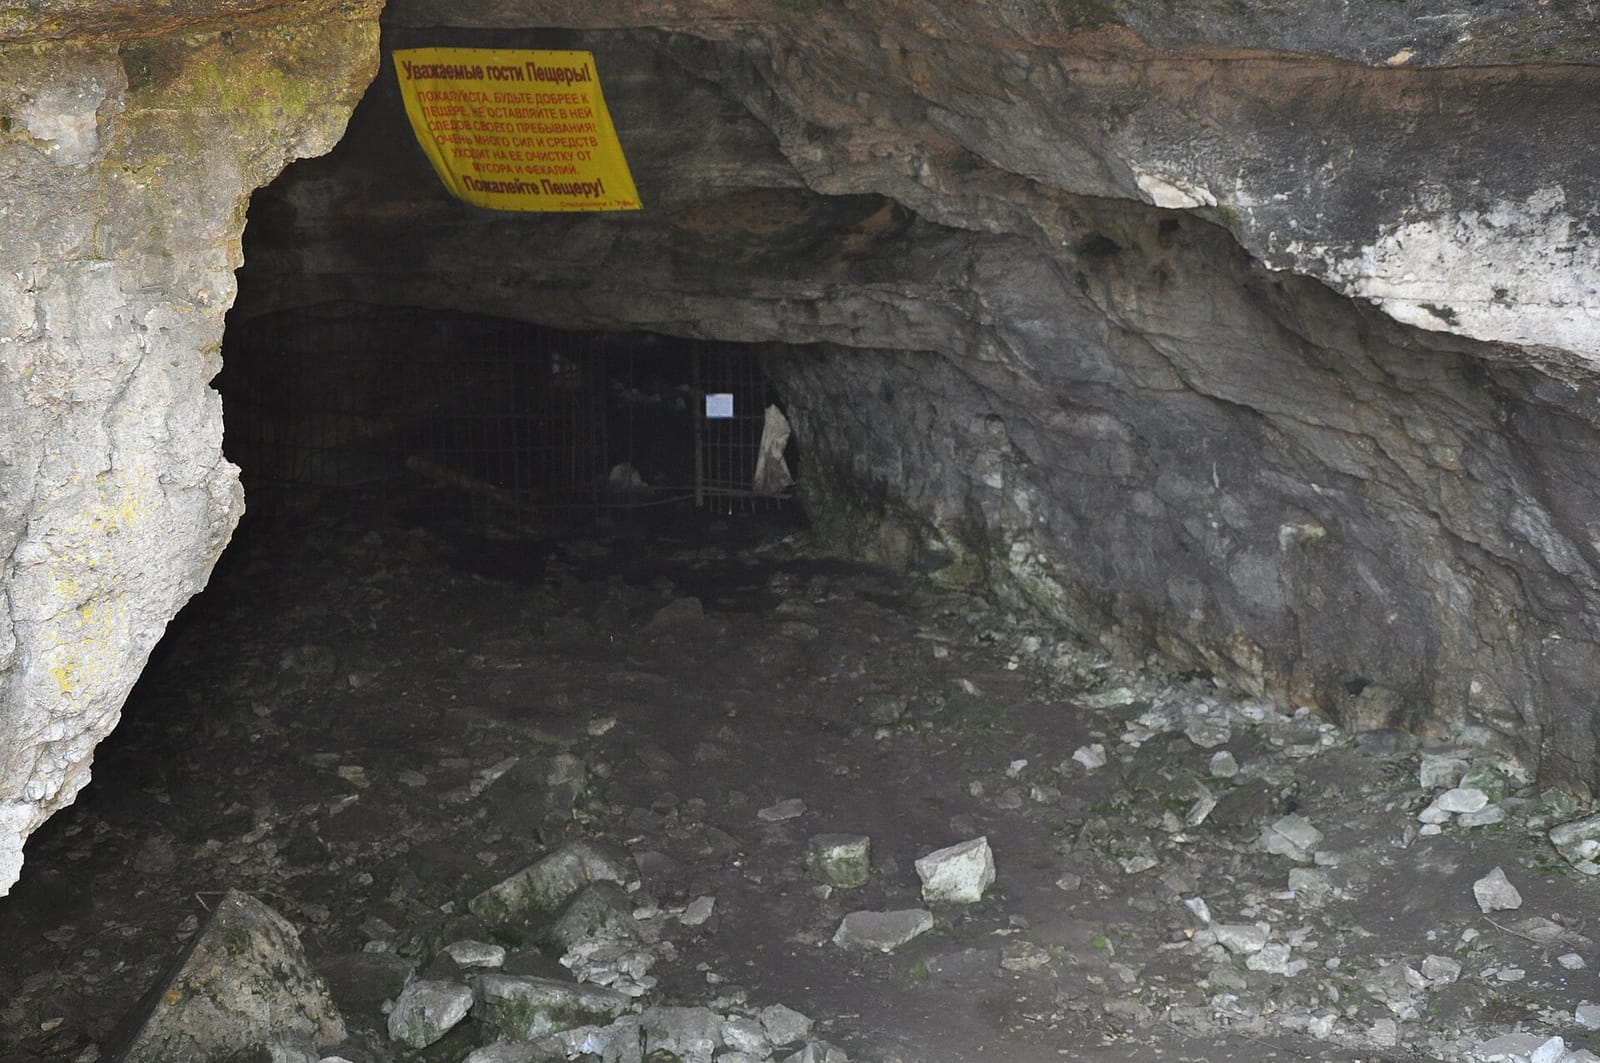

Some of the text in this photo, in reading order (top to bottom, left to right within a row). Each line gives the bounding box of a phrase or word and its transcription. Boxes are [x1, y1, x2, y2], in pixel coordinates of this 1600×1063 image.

[401, 60, 592, 87] Уважаемые гости Пещеры!
[494, 91, 533, 105] БУДЬТЕ
[535, 91, 580, 106] ДОБРЕЕ
[580, 93, 589, 105] К
[472, 106, 486, 118] НЕ
[487, 105, 558, 119] ОСТАВЛЯЙТЕ
[560, 108, 567, 119] В
[569, 106, 594, 119] НЕЙ
[427, 119, 597, 134] СЛЕДОВ СВОЕГО ПРЕБЫВАНИЯ!
[436, 134, 598, 149] ОЧЕНЬ МНОГО СИЛ И СРЕДСТВ
[451, 147, 592, 162] УХОДИТ НА ЕЕ ОЧИСТКУ ОТ
[472, 162, 514, 174] МУСОРА
[515, 163, 523, 174] И
[462, 175, 606, 198] Пожалейте Пещеру!
